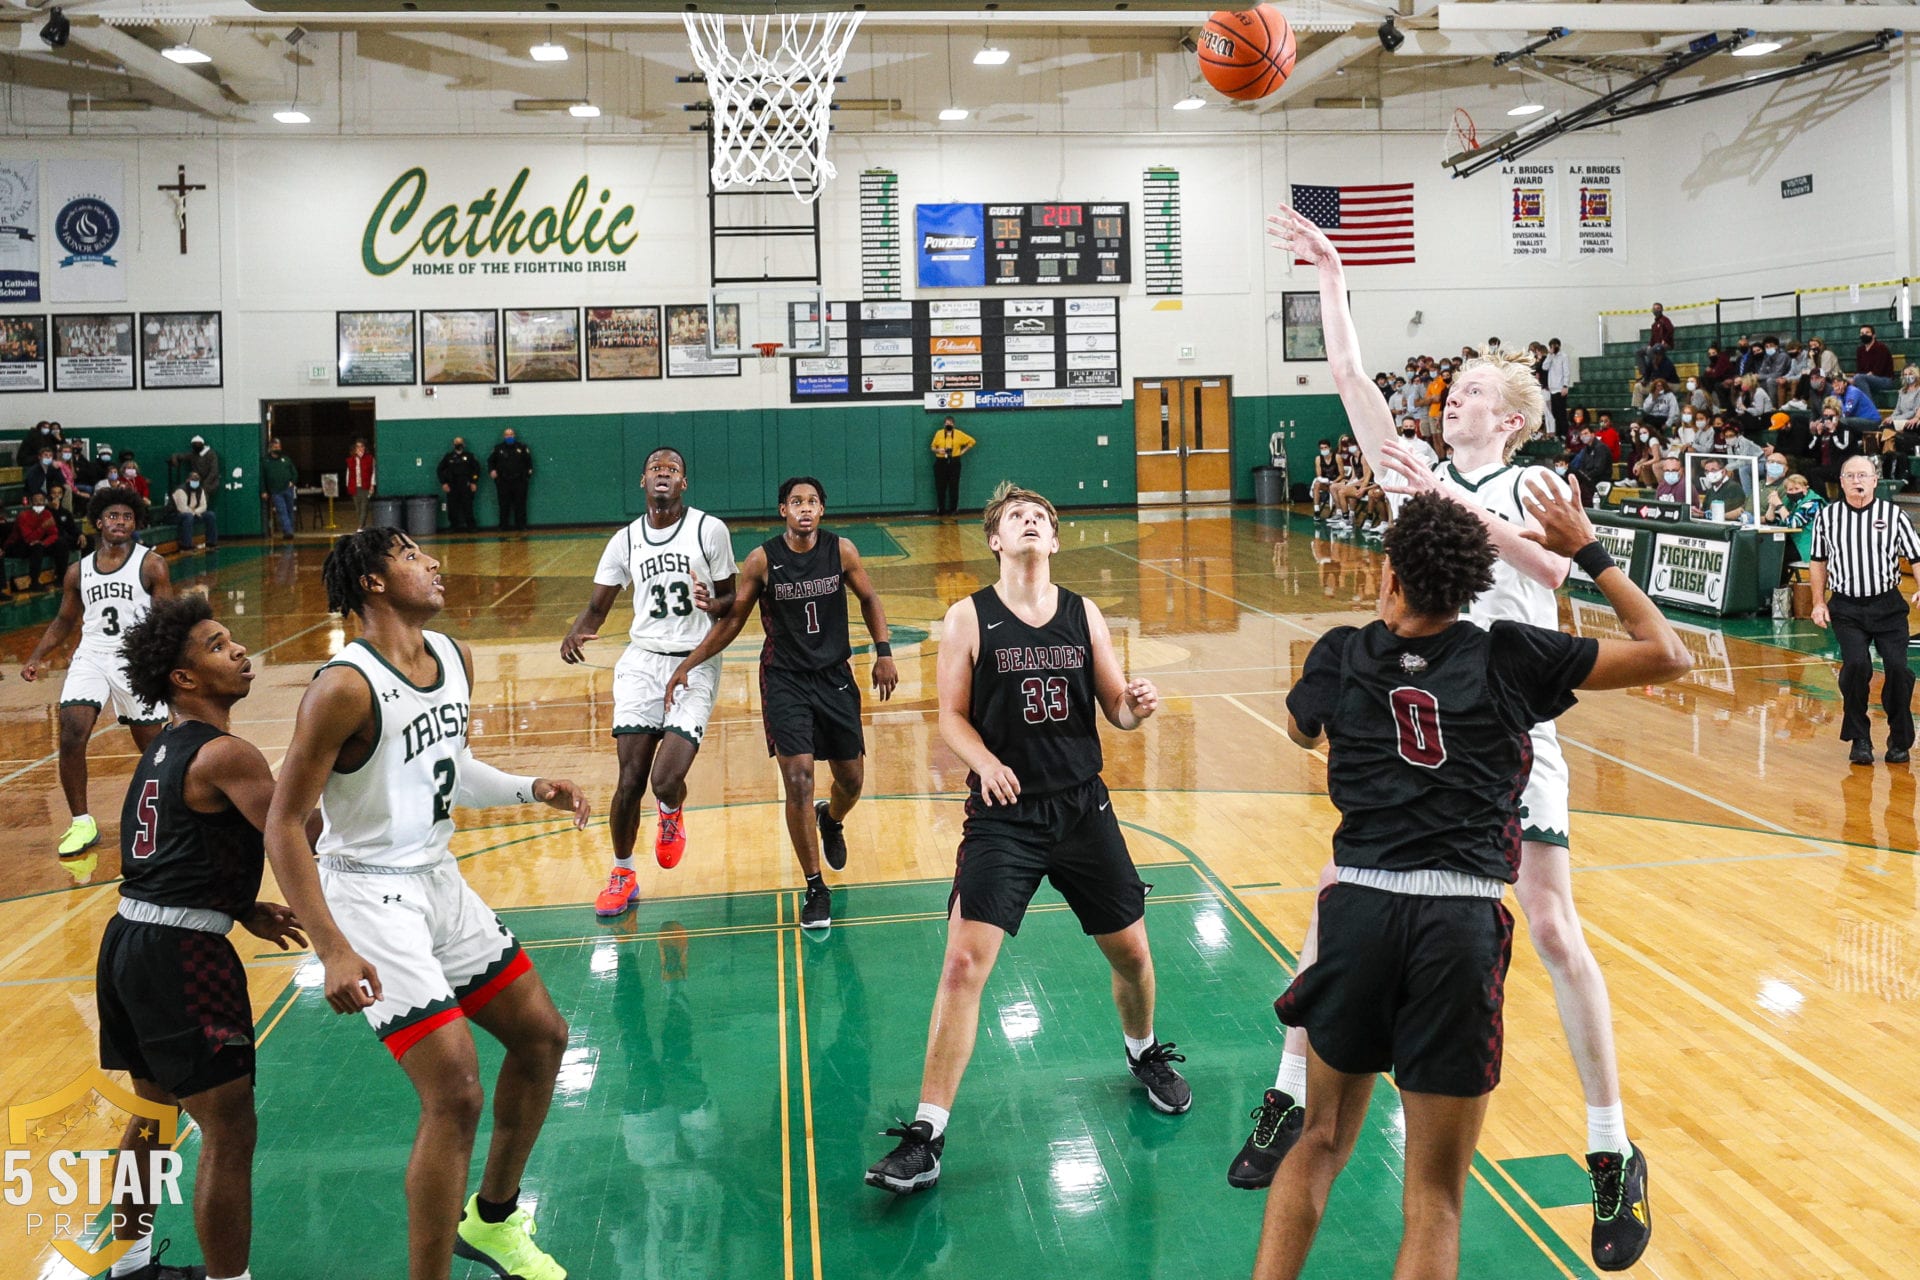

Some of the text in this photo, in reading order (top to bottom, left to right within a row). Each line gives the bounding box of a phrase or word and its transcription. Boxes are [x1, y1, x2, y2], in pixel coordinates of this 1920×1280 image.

[1502, 166, 1554, 174] A.F. BRIDGES
[1514, 176, 1543, 184] AWARD
[1570, 166, 1621, 174] A.F. BRIDGES
[1581, 176, 1610, 184] AWARD
[362, 166, 639, 276] Catholic
[988, 206, 1024, 216] GUEST
[1042, 205, 1082, 226] 2:07
[1091, 206, 1123, 215] HOME
[998, 219, 1021, 239] 35
[1096, 217, 1122, 238] 41
[62, 231, 114, 253] HONOR ROLL
[412, 260, 627, 275] HOME OF THE FIGHTING IRISH
[4, 279, 38, 288] Catholic
[312, 366, 326, 376] EXIT
[948, 391, 964, 408] 8
[976, 394, 1023, 404] EdFinancial
[1596, 526, 1612, 535] WELCOME
[1678, 538, 1706, 548] HOME OF THE
[640, 552, 691, 583] IRISH
[1658, 543, 1724, 574] FIGHTING
[775, 574, 840, 600] BEARDEN
[1668, 568, 1708, 596] IRISH
[86, 582, 134, 605] IRISH
[650, 580, 694, 619] 33
[102, 606, 121, 636] 3
[804, 601, 820, 634] 1
[994, 646, 1086, 673] BEARDEN
[1020, 676, 1070, 724] 33
[402, 702, 469, 764] IRISH
[1388, 686, 1448, 770] 0
[432, 756, 456, 827] 2
[132, 779, 160, 860] 5
